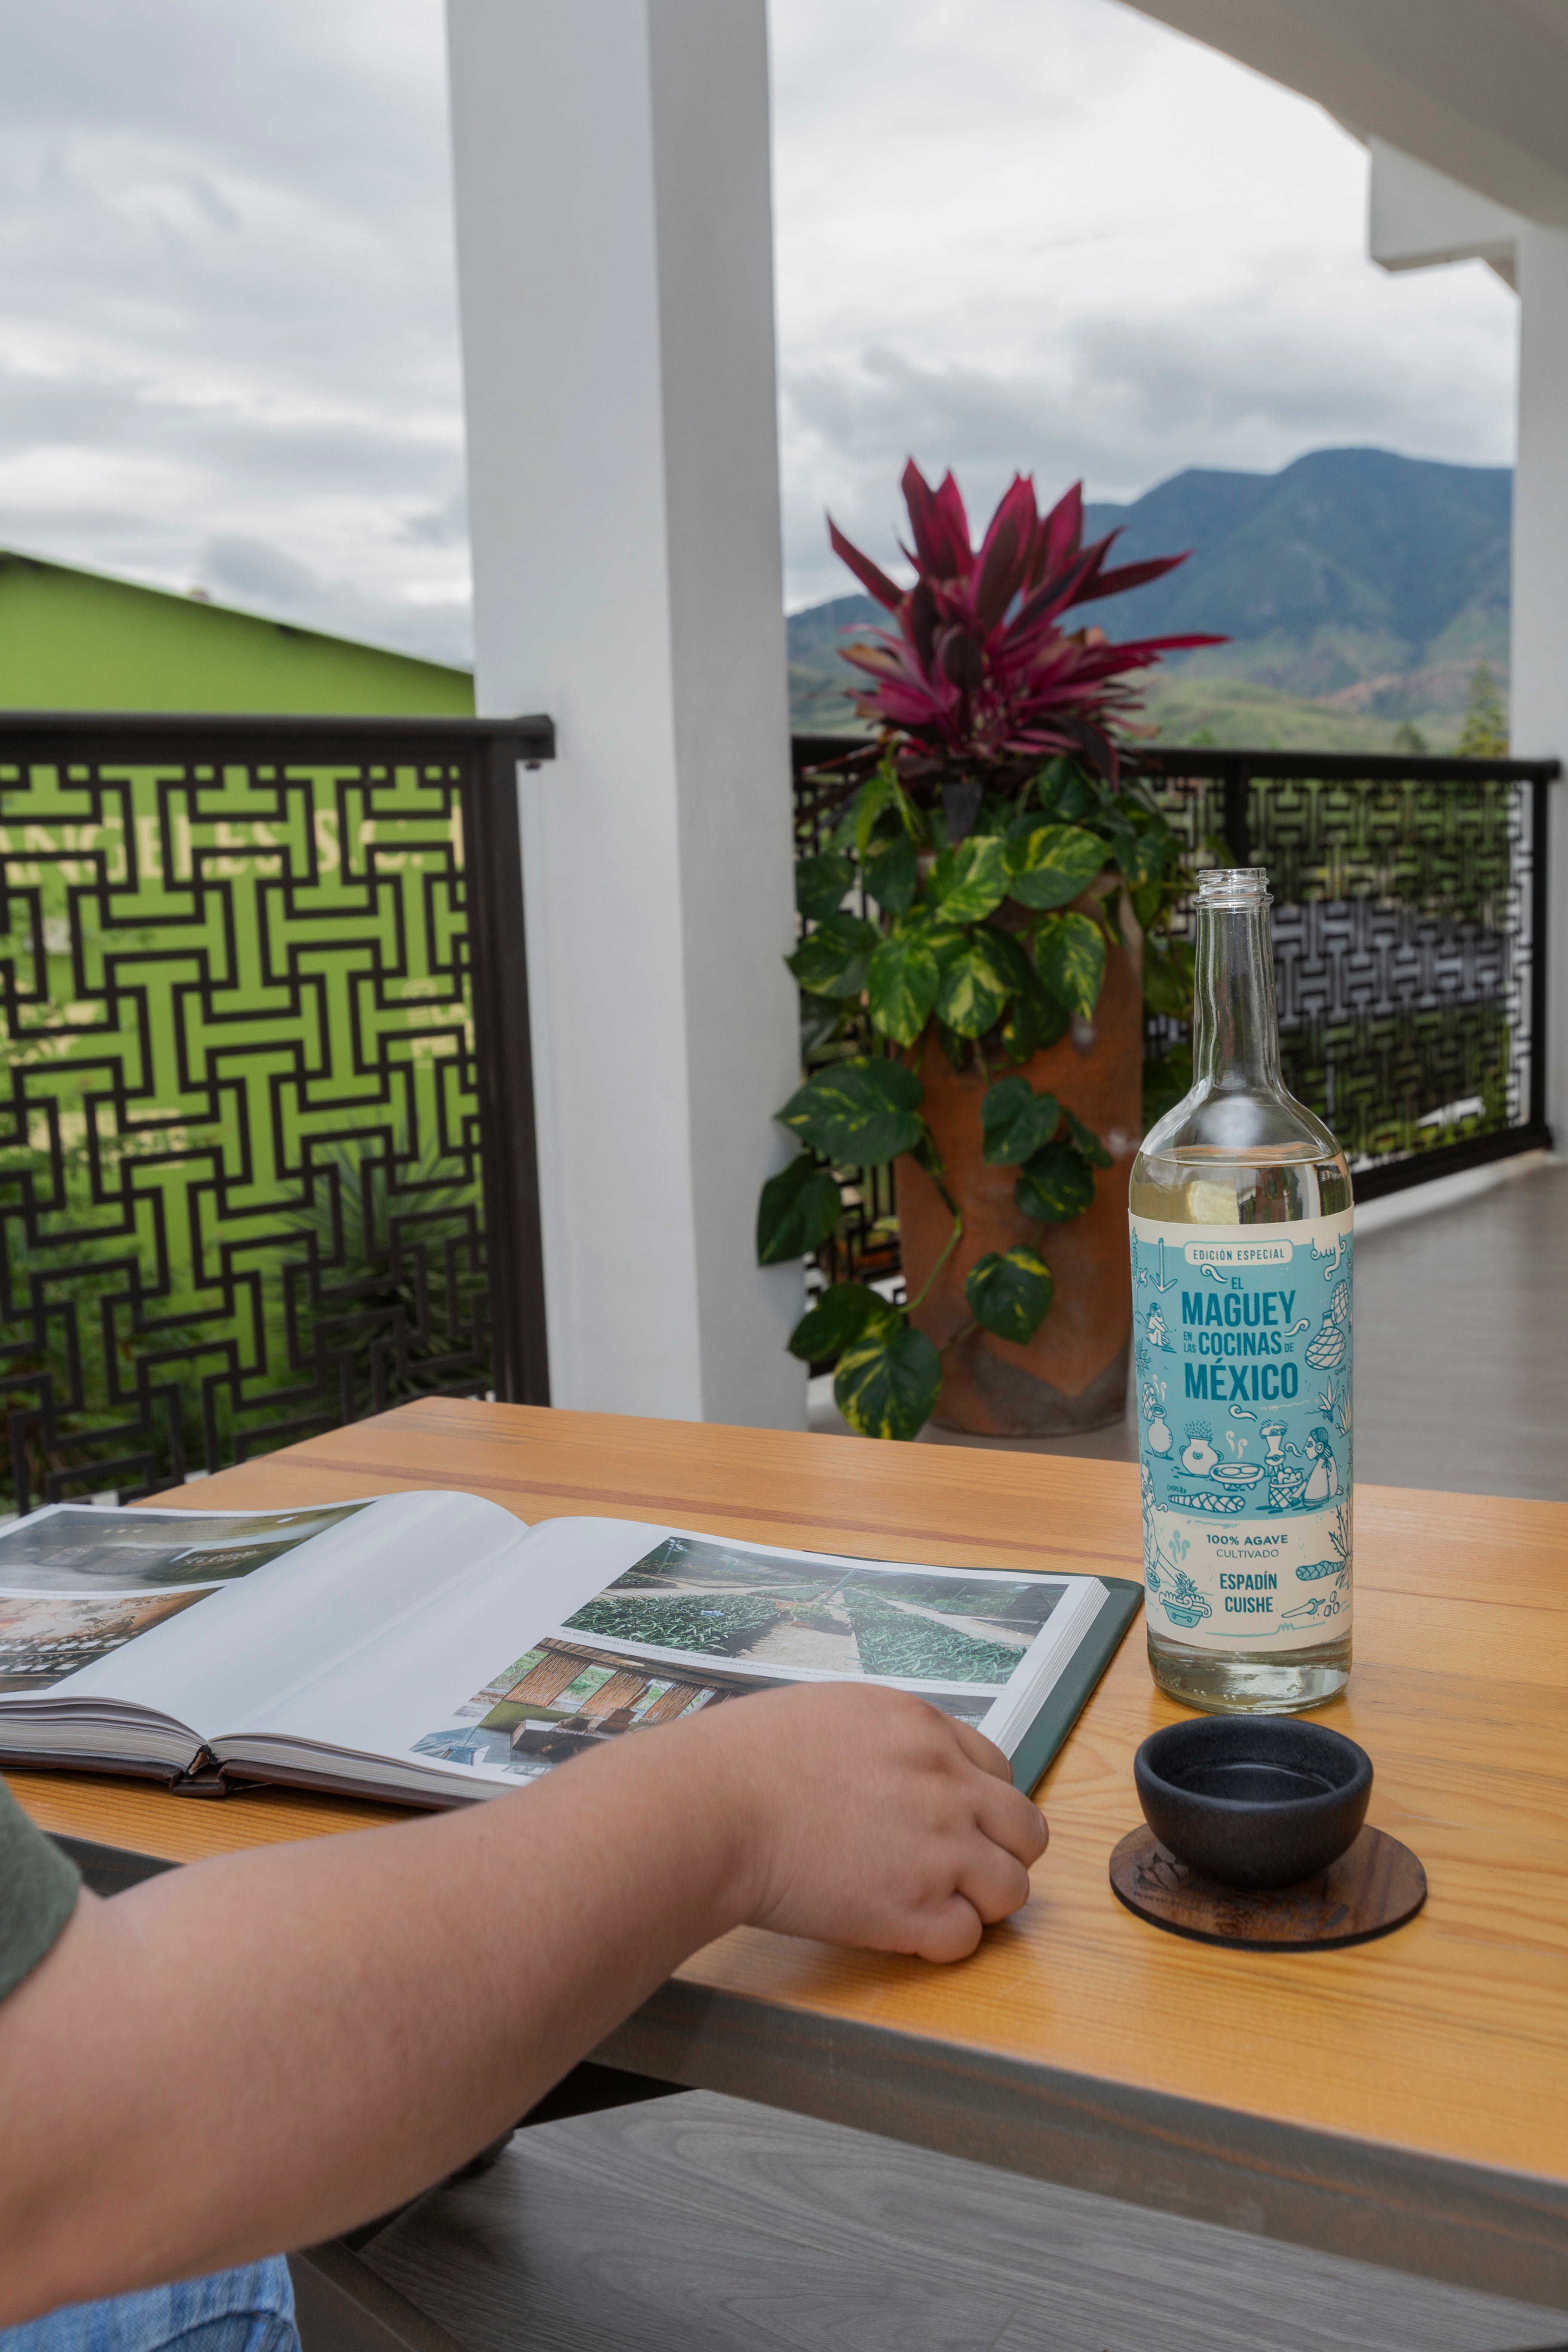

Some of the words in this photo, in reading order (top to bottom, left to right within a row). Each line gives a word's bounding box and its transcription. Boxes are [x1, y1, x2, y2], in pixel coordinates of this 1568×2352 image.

[1193, 1249, 1233, 1261] EDICIÓN
[1237, 1248, 1285, 1260] ESPECIAL
[1231, 1277, 1244, 1289] EL
[1182, 1289, 1296, 1327] MAGUEY
[1183, 1331, 1192, 1341] EN
[1183, 1343, 1196, 1354] LAS
[1198, 1331, 1282, 1356] COCINAS
[1285, 1342, 1294, 1353] DE
[1184, 1357, 1298, 1401] MÉXICO
[1207, 1534, 1240, 1546] 100%
[1243, 1534, 1289, 1545] AGAVE
[1216, 1549, 1280, 1559] CULTIVADO
[1219, 1571, 1277, 1590] ESPADÍN
[1225, 1596, 1274, 1613] CUISHE
[592, 1637, 623, 1645] MINERO
